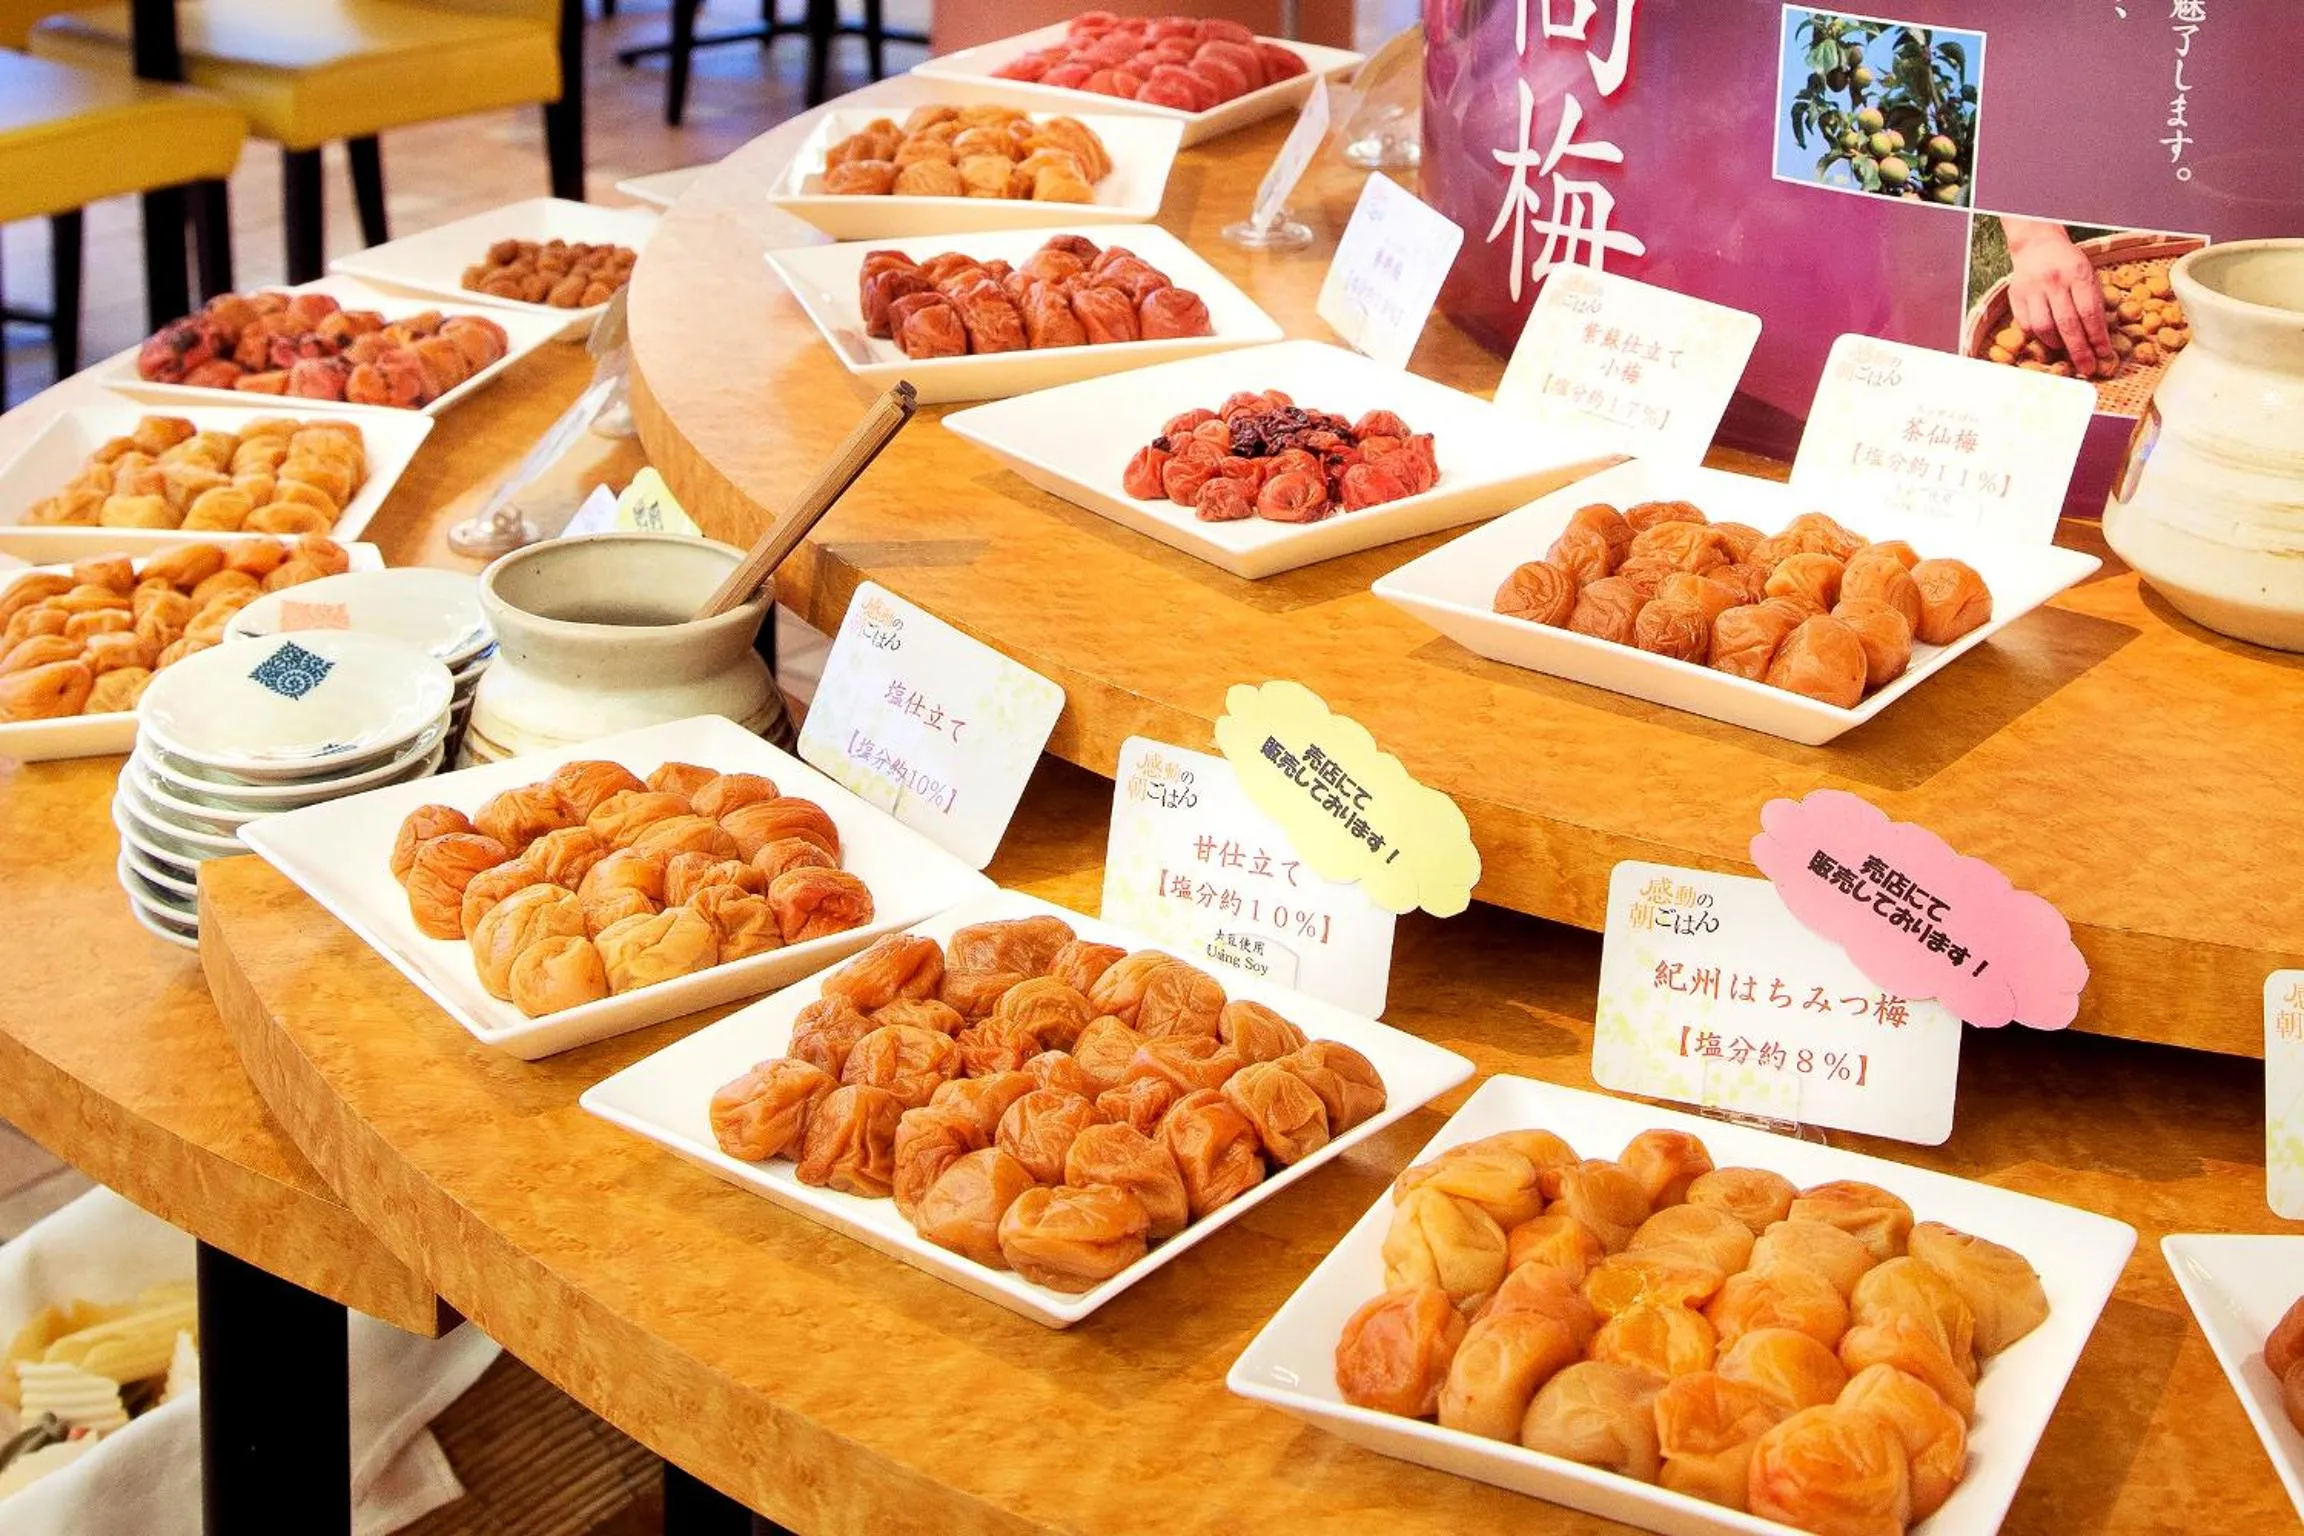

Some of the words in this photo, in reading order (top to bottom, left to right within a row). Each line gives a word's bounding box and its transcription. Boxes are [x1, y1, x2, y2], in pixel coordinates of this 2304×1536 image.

[1834, 361, 1902, 389] ごはん
[849, 609, 902, 652] ごはん
[884, 679, 967, 745] 塩仕立て
[1302, 743, 1373, 811] 売店にて
[1192, 834, 1301, 888] 甘仕立て
[1640, 876, 1715, 910] 感動の
[1807, 849, 1990, 978] 販売しております！
[1859, 853, 1952, 924] 売店にて
[1628, 901, 1721, 936] 朝ごはん
[1244, 954, 1269, 977] Soy
[1652, 959, 1912, 1029] 紀州はちみつ梅
